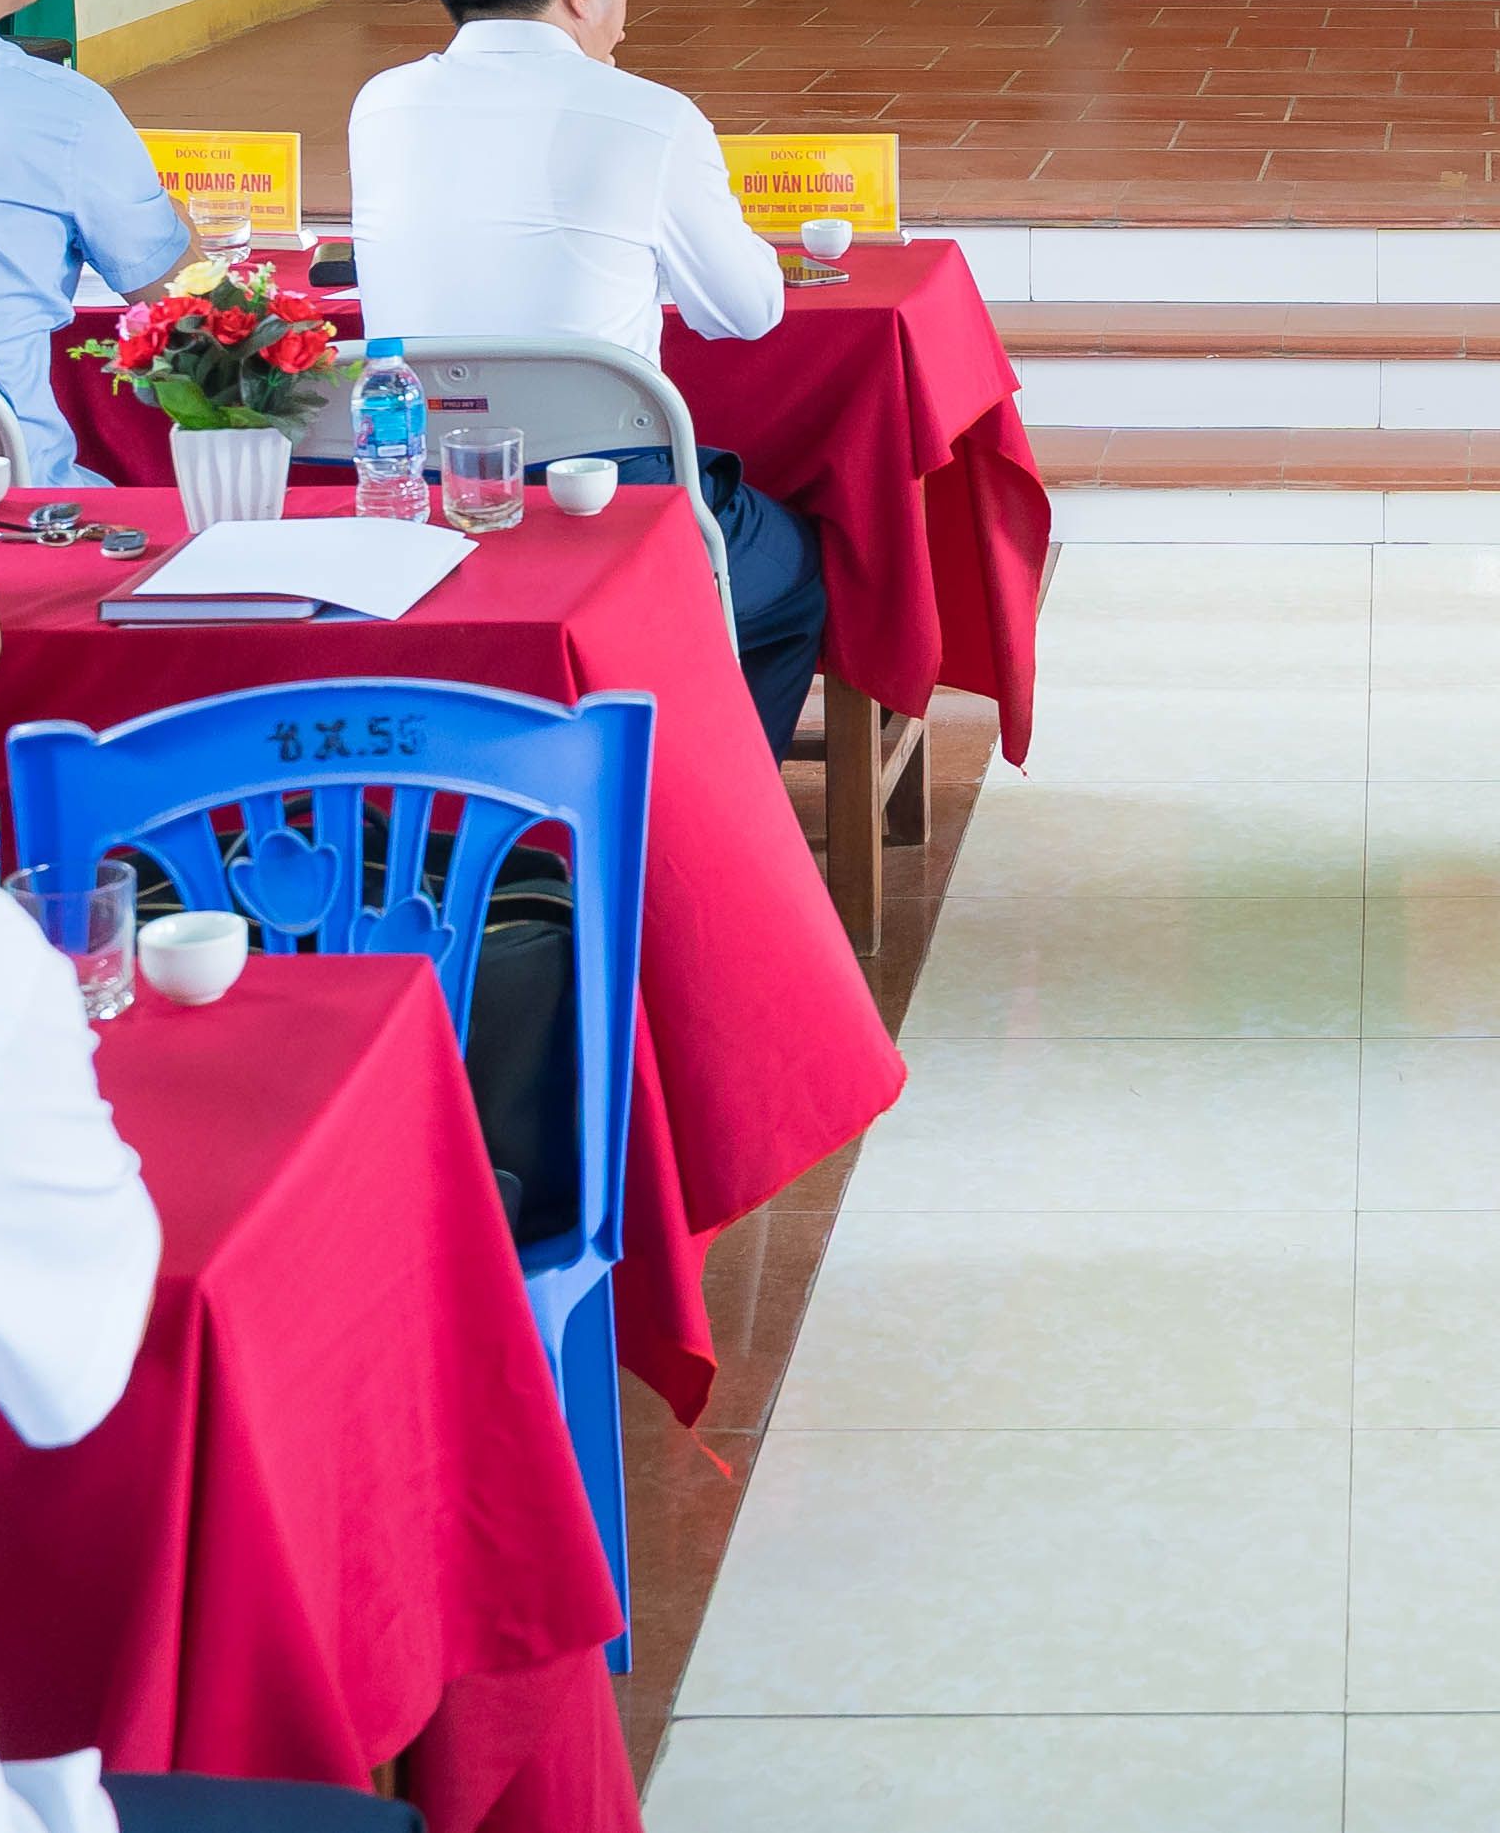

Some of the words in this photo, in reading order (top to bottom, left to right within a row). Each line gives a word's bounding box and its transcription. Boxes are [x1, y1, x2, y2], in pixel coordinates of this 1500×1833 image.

[185, 172, 236, 193] QUANG
[240, 174, 272, 193] ANH
[743, 171, 768, 194] BÙI
[772, 171, 801, 194] VĂN
[806, 172, 854, 193] LƯƠNG
